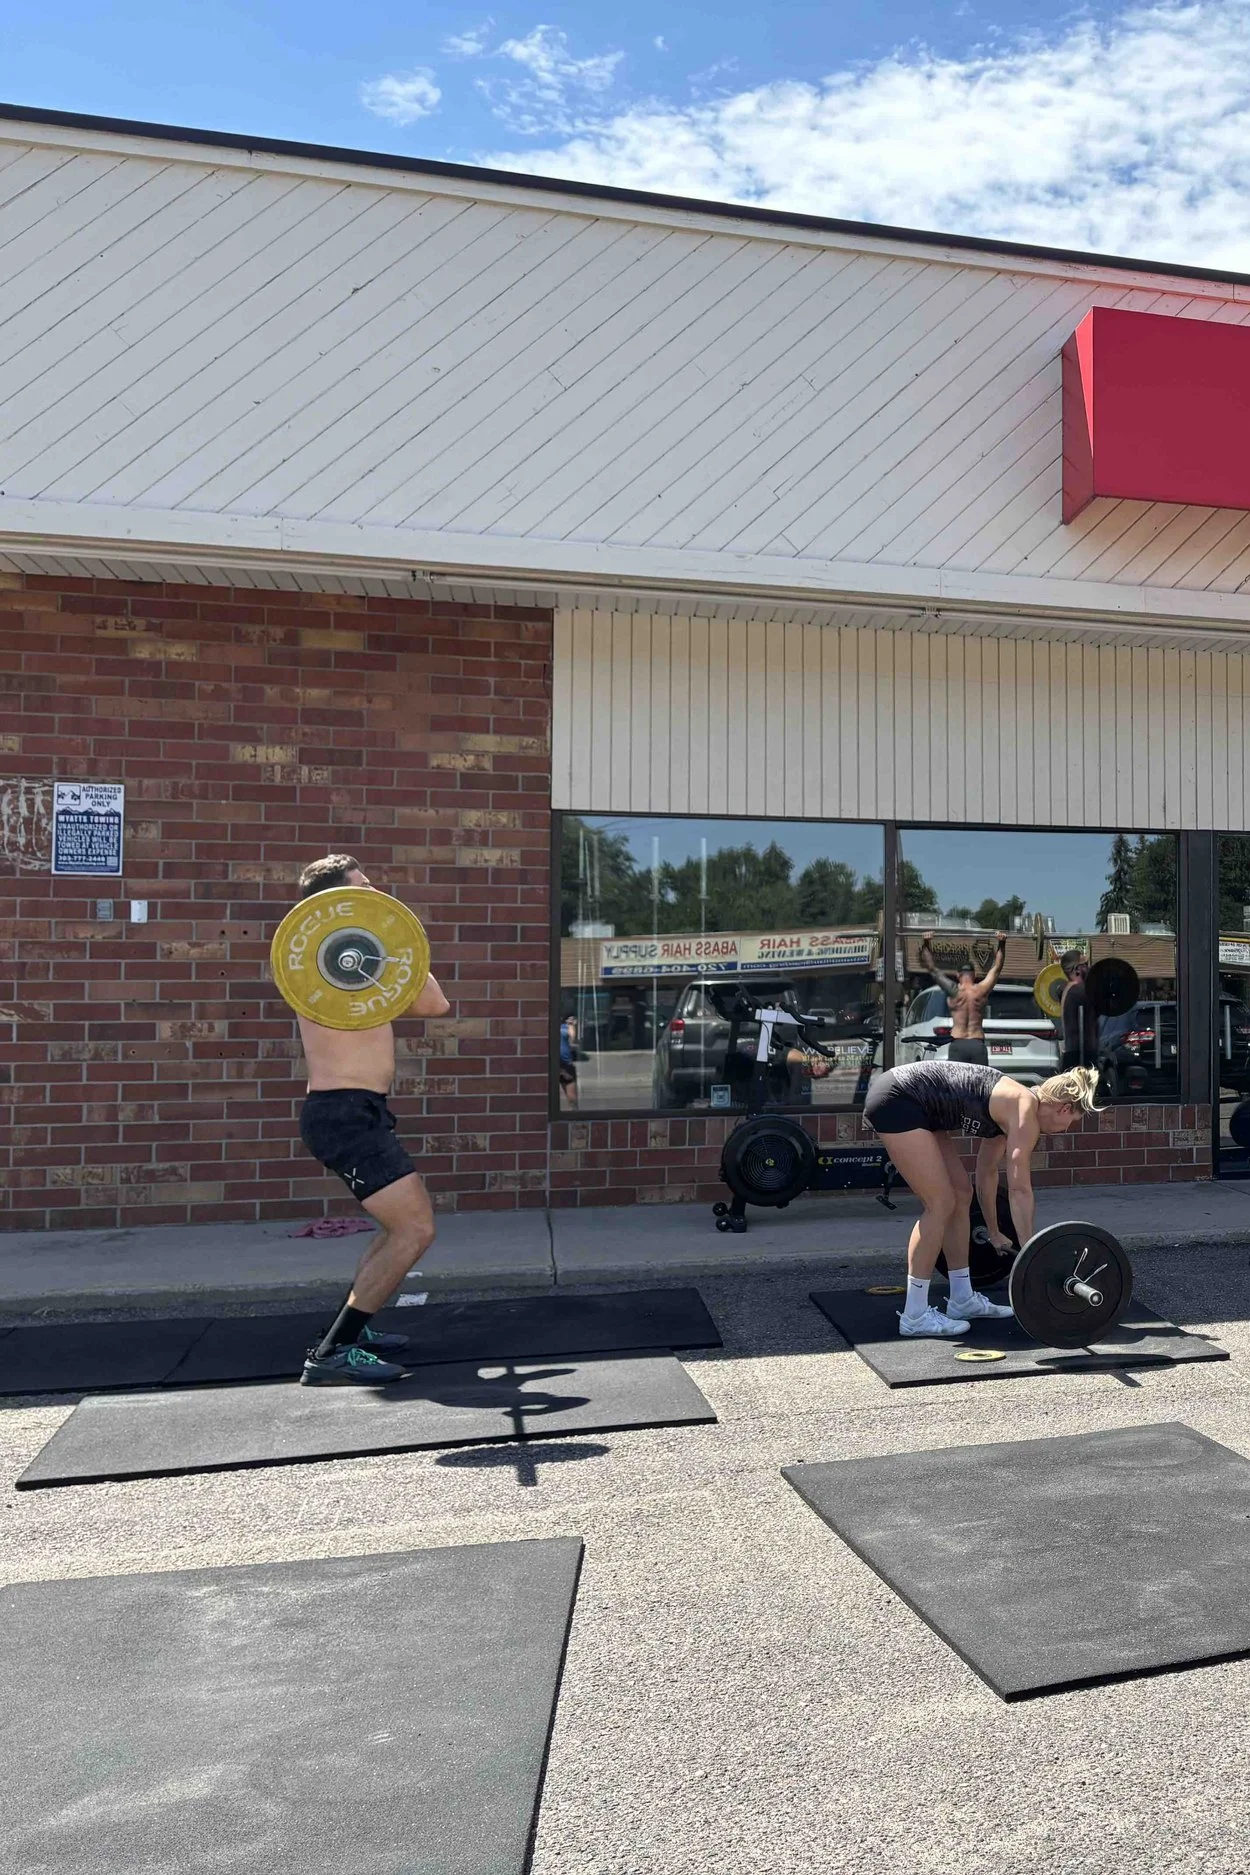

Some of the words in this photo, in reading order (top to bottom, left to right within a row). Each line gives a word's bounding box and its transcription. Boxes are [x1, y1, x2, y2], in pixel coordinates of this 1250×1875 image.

[82, 786, 122, 794] AUTHORIZED
[90, 815, 119, 824] TOWING
[287, 900, 356, 971] ROGUE
[347, 947, 414, 1017] ROGUE
[833, 1156, 874, 1165] concept
